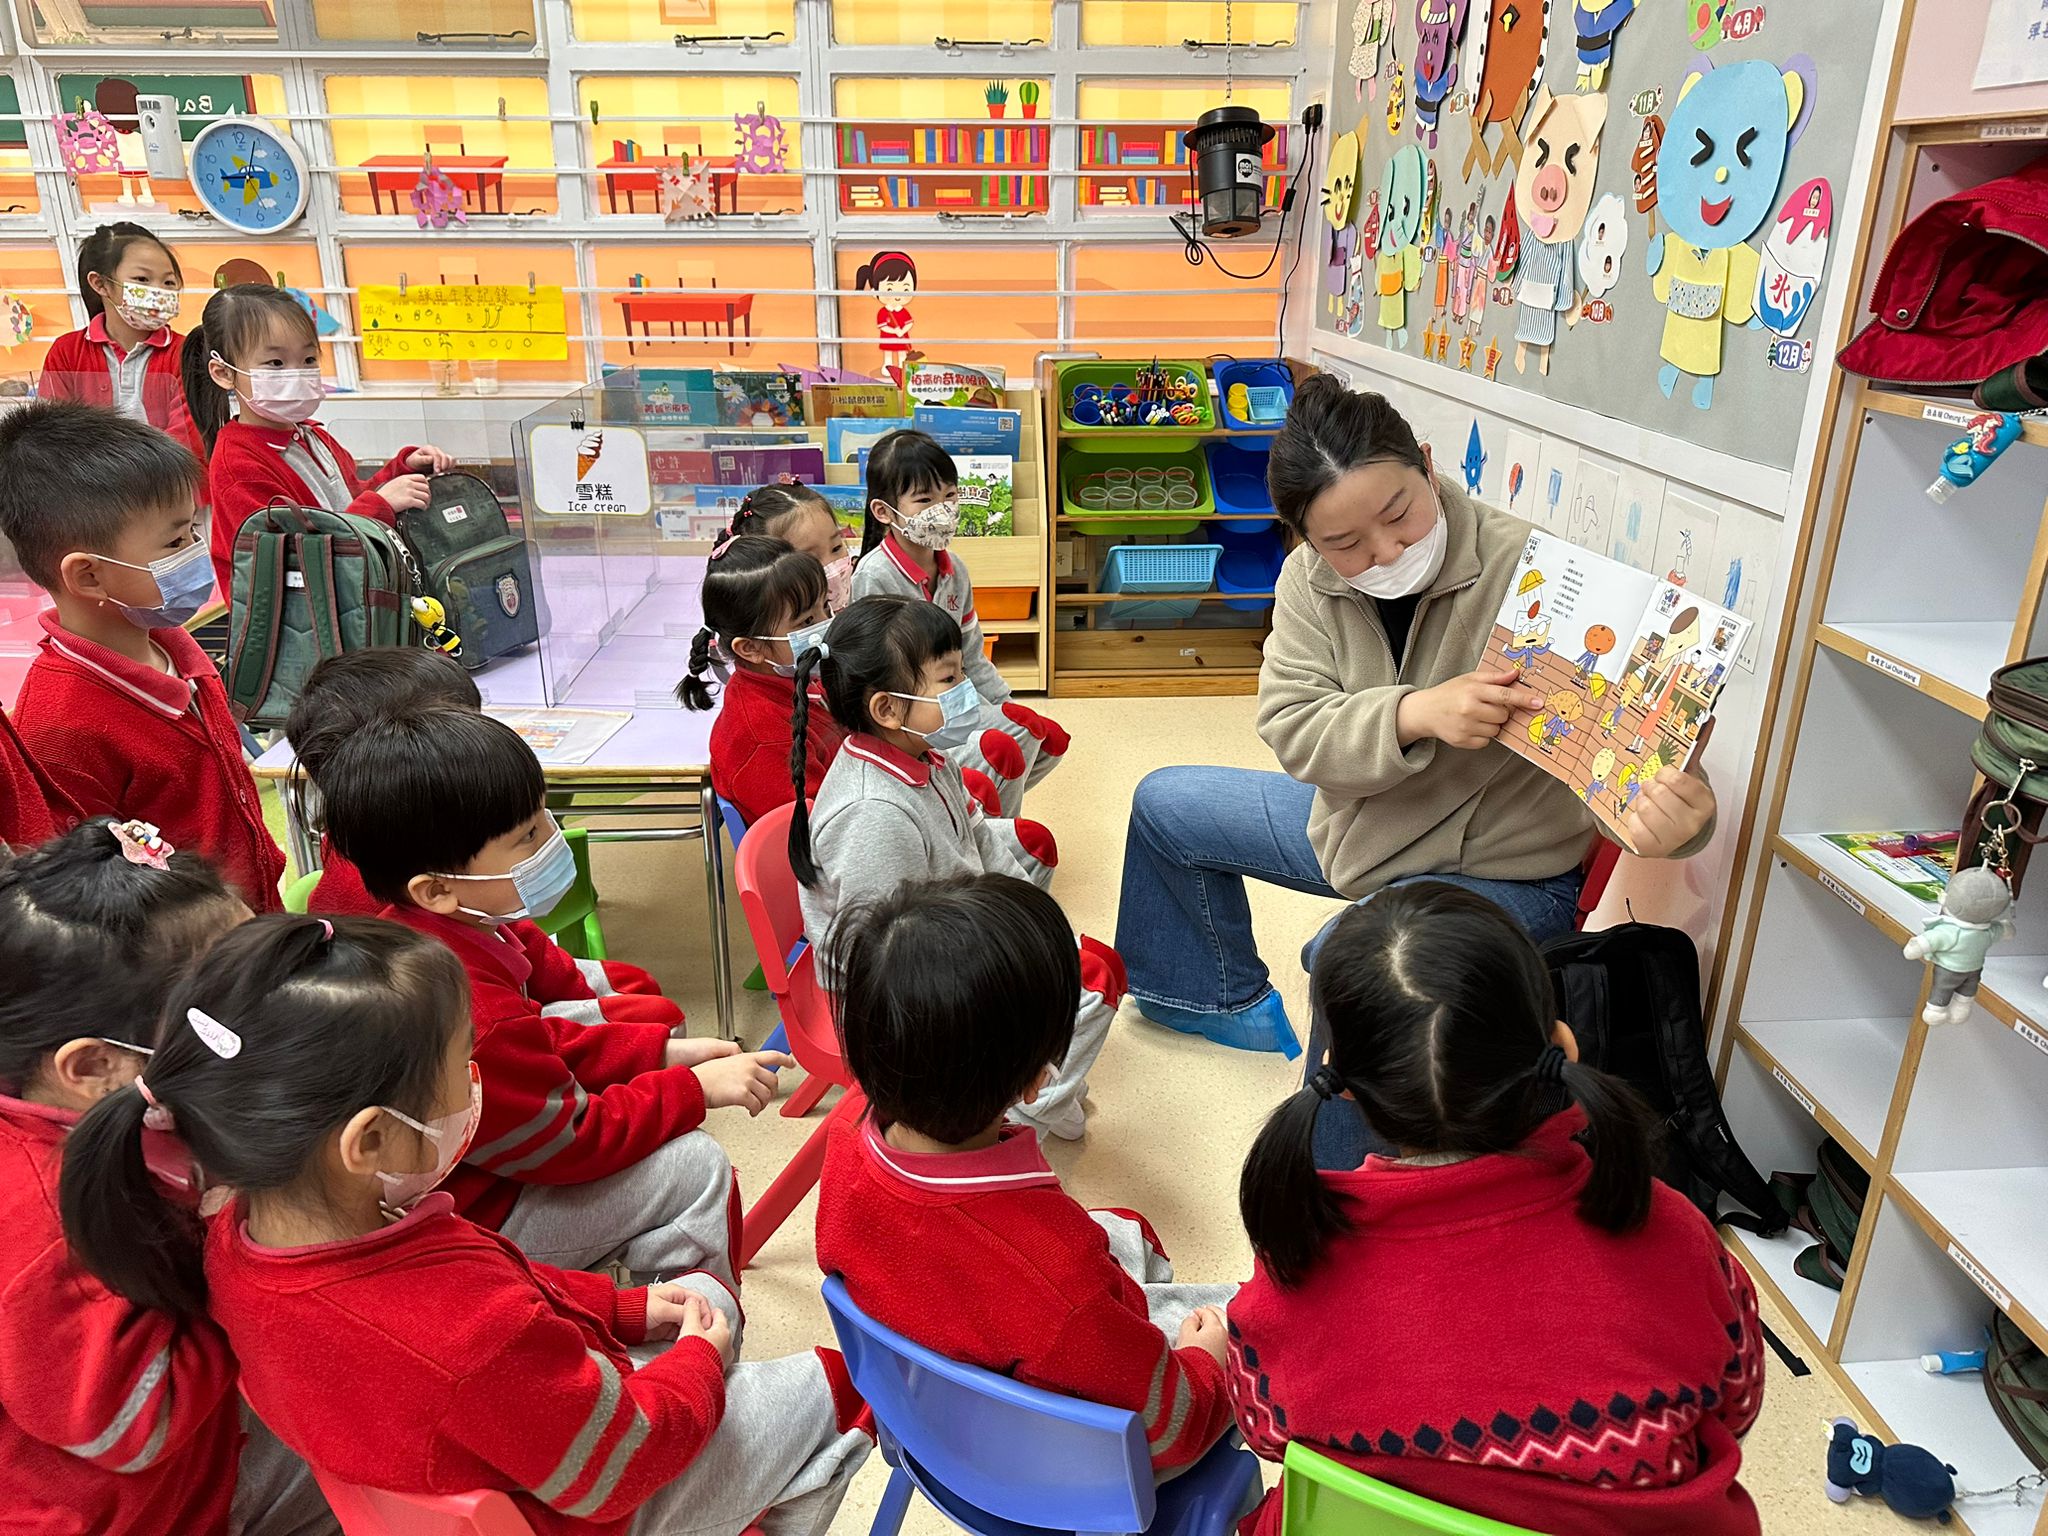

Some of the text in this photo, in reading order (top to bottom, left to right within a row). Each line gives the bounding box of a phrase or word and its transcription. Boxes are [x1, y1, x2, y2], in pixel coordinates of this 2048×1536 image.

[1733, 11, 1752, 34] 4月
[1638, 93, 1655, 113] 11月
[216, 139, 225, 149] 11
[232, 131, 246, 145] 12
[205, 154, 217, 164] 10
[1778, 344, 1801, 367] 12月
[575, 483, 613, 500] 雪糕
[568, 501, 627, 512] Ice cream
